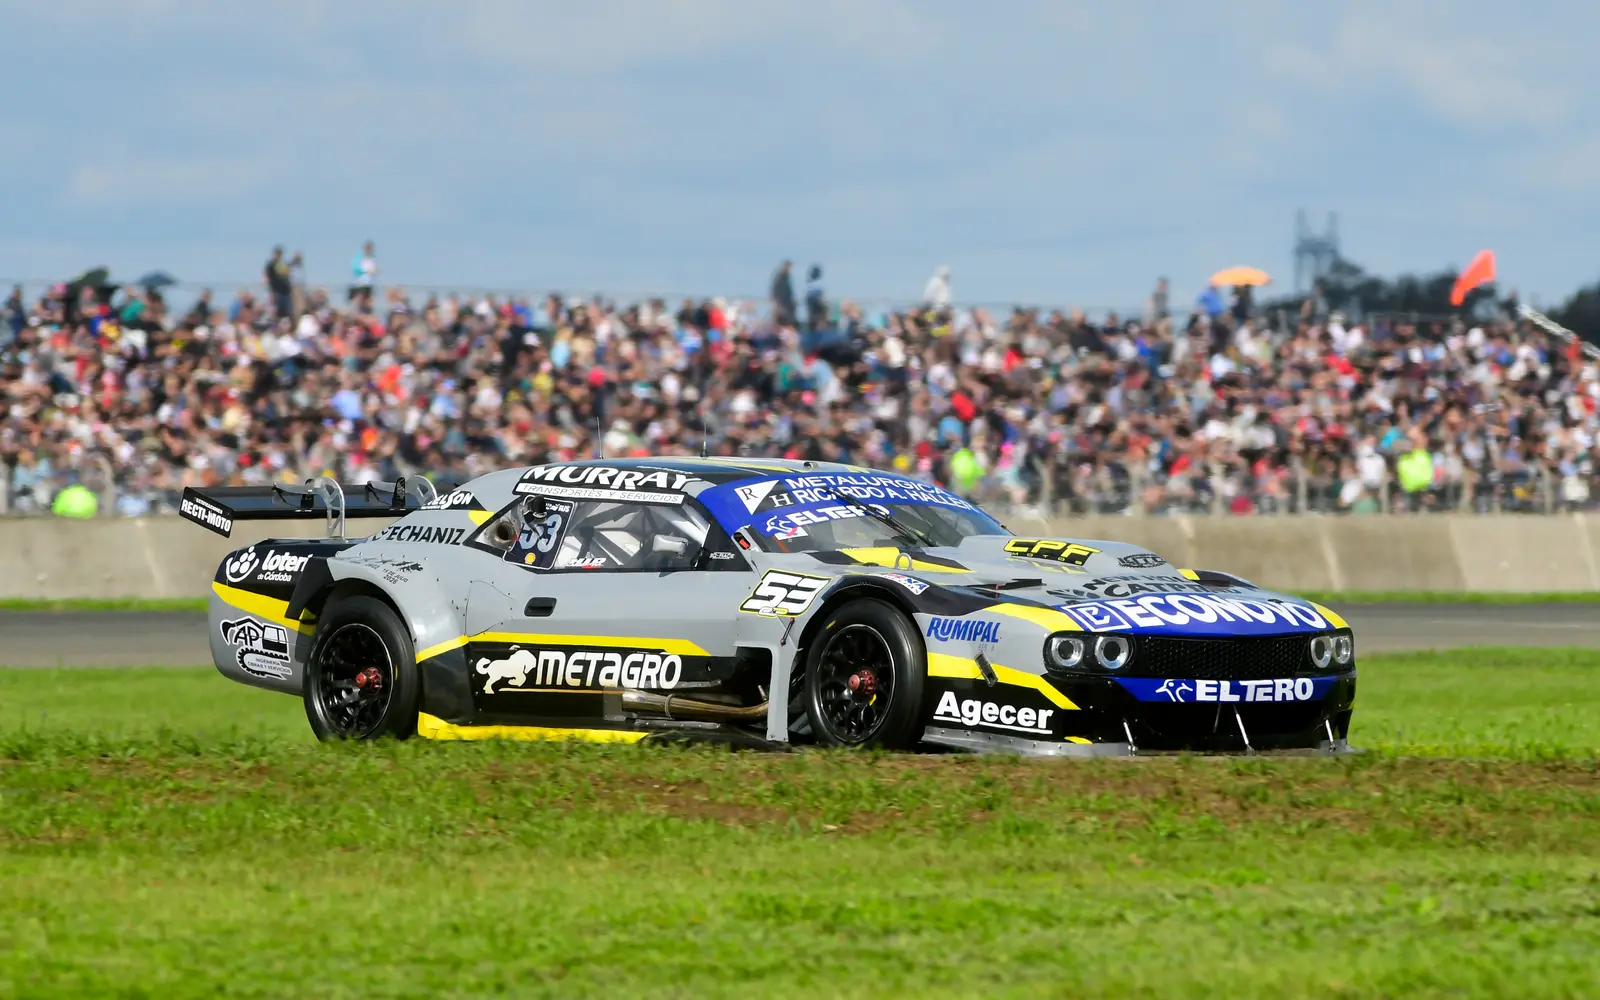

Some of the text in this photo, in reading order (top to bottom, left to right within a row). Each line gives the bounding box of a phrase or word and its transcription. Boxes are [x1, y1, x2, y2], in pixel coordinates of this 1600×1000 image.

[523, 466, 702, 490] MURRAY
[785, 476, 952, 497] METALURGICA
[522, 484, 602, 497] TRANSPORTES
[619, 492, 679, 503] SERVICIOS
[180, 498, 232, 532] RECTI-MOTO
[786, 510, 830, 526] EL
[519, 513, 562, 552] 53
[1004, 539, 1101, 558] CPF
[264, 571, 293, 582] Córdoba
[742, 572, 831, 614] 53
[1112, 595, 1327, 629] ECONOVO
[926, 617, 1001, 643] RUMIPAL
[1196, 678, 1314, 701] EL TERO
[934, 690, 1054, 729] Agecer
